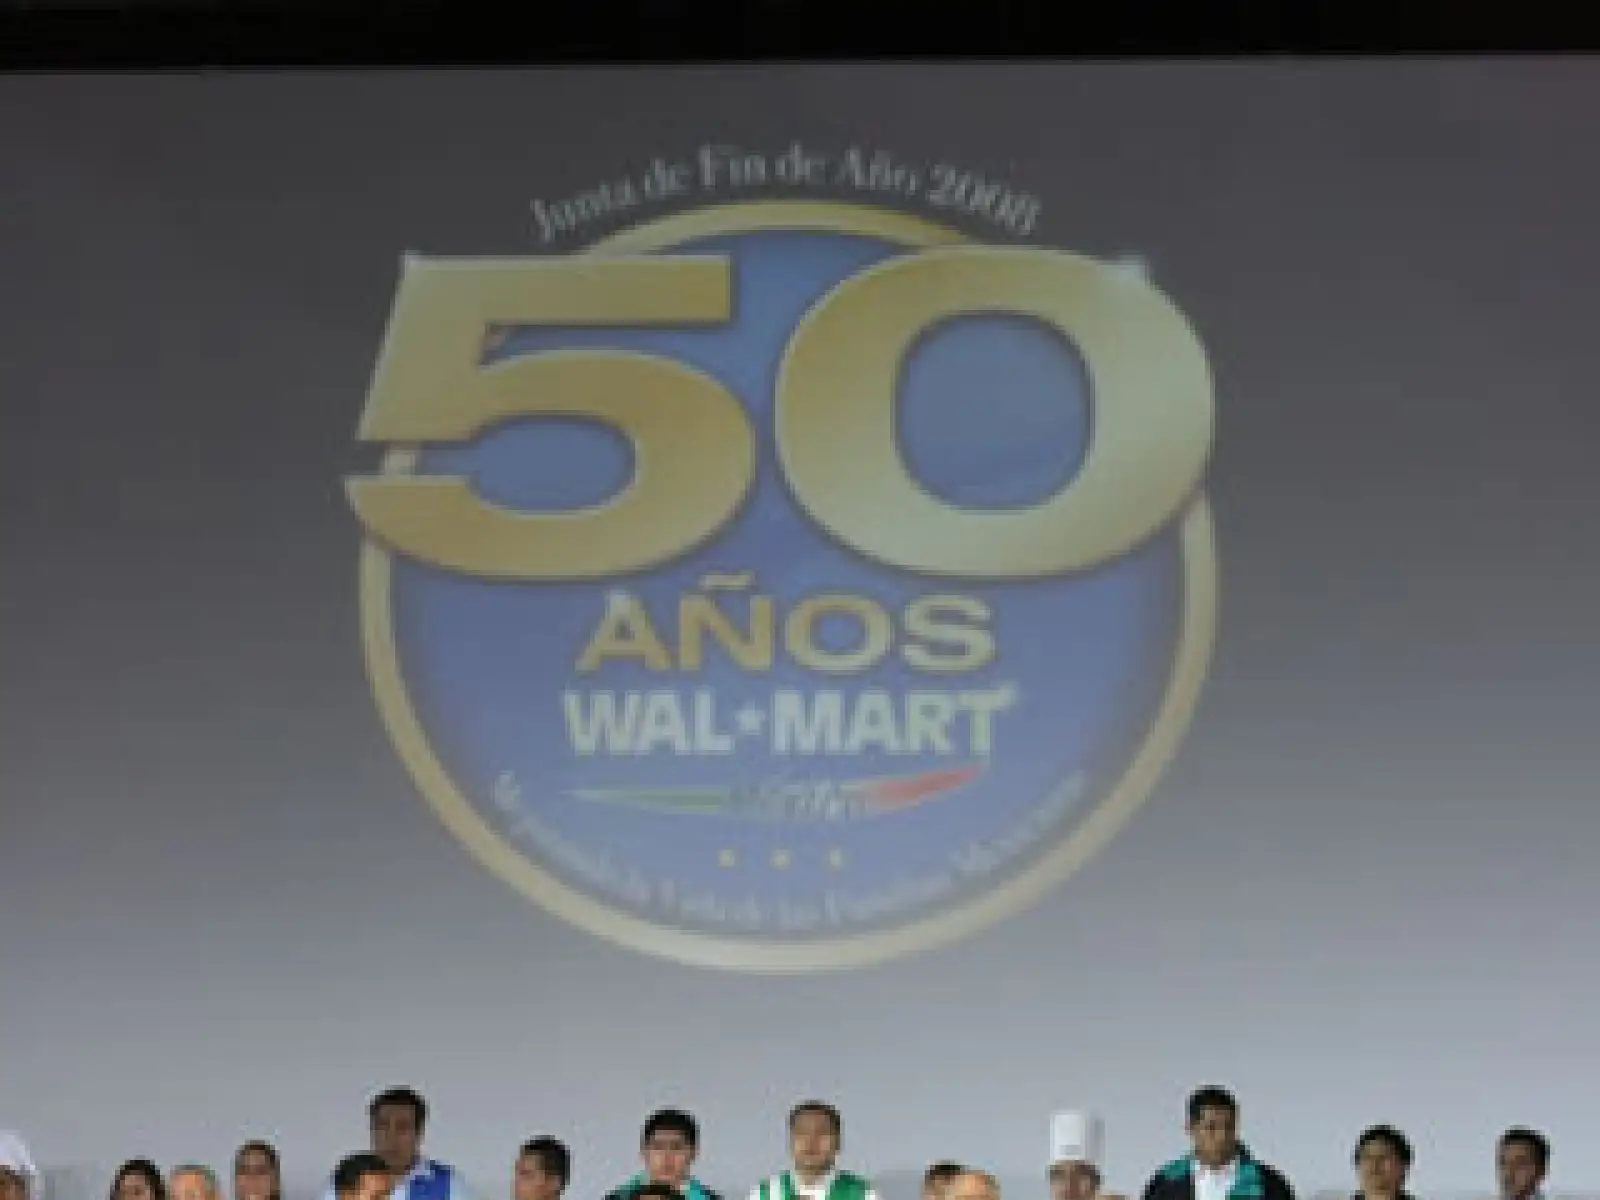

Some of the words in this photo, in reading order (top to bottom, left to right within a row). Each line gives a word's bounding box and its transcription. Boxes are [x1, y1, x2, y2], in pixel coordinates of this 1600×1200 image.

[529, 172, 637, 244] Junta
[642, 157, 692, 201] de
[699, 142, 767, 188] Fin
[775, 139, 826, 187] de
[838, 145, 917, 198] Año
[926, 162, 1042, 238] 2008
[344, 246, 1215, 578] 50
[575, 572, 998, 674] AÑOS
